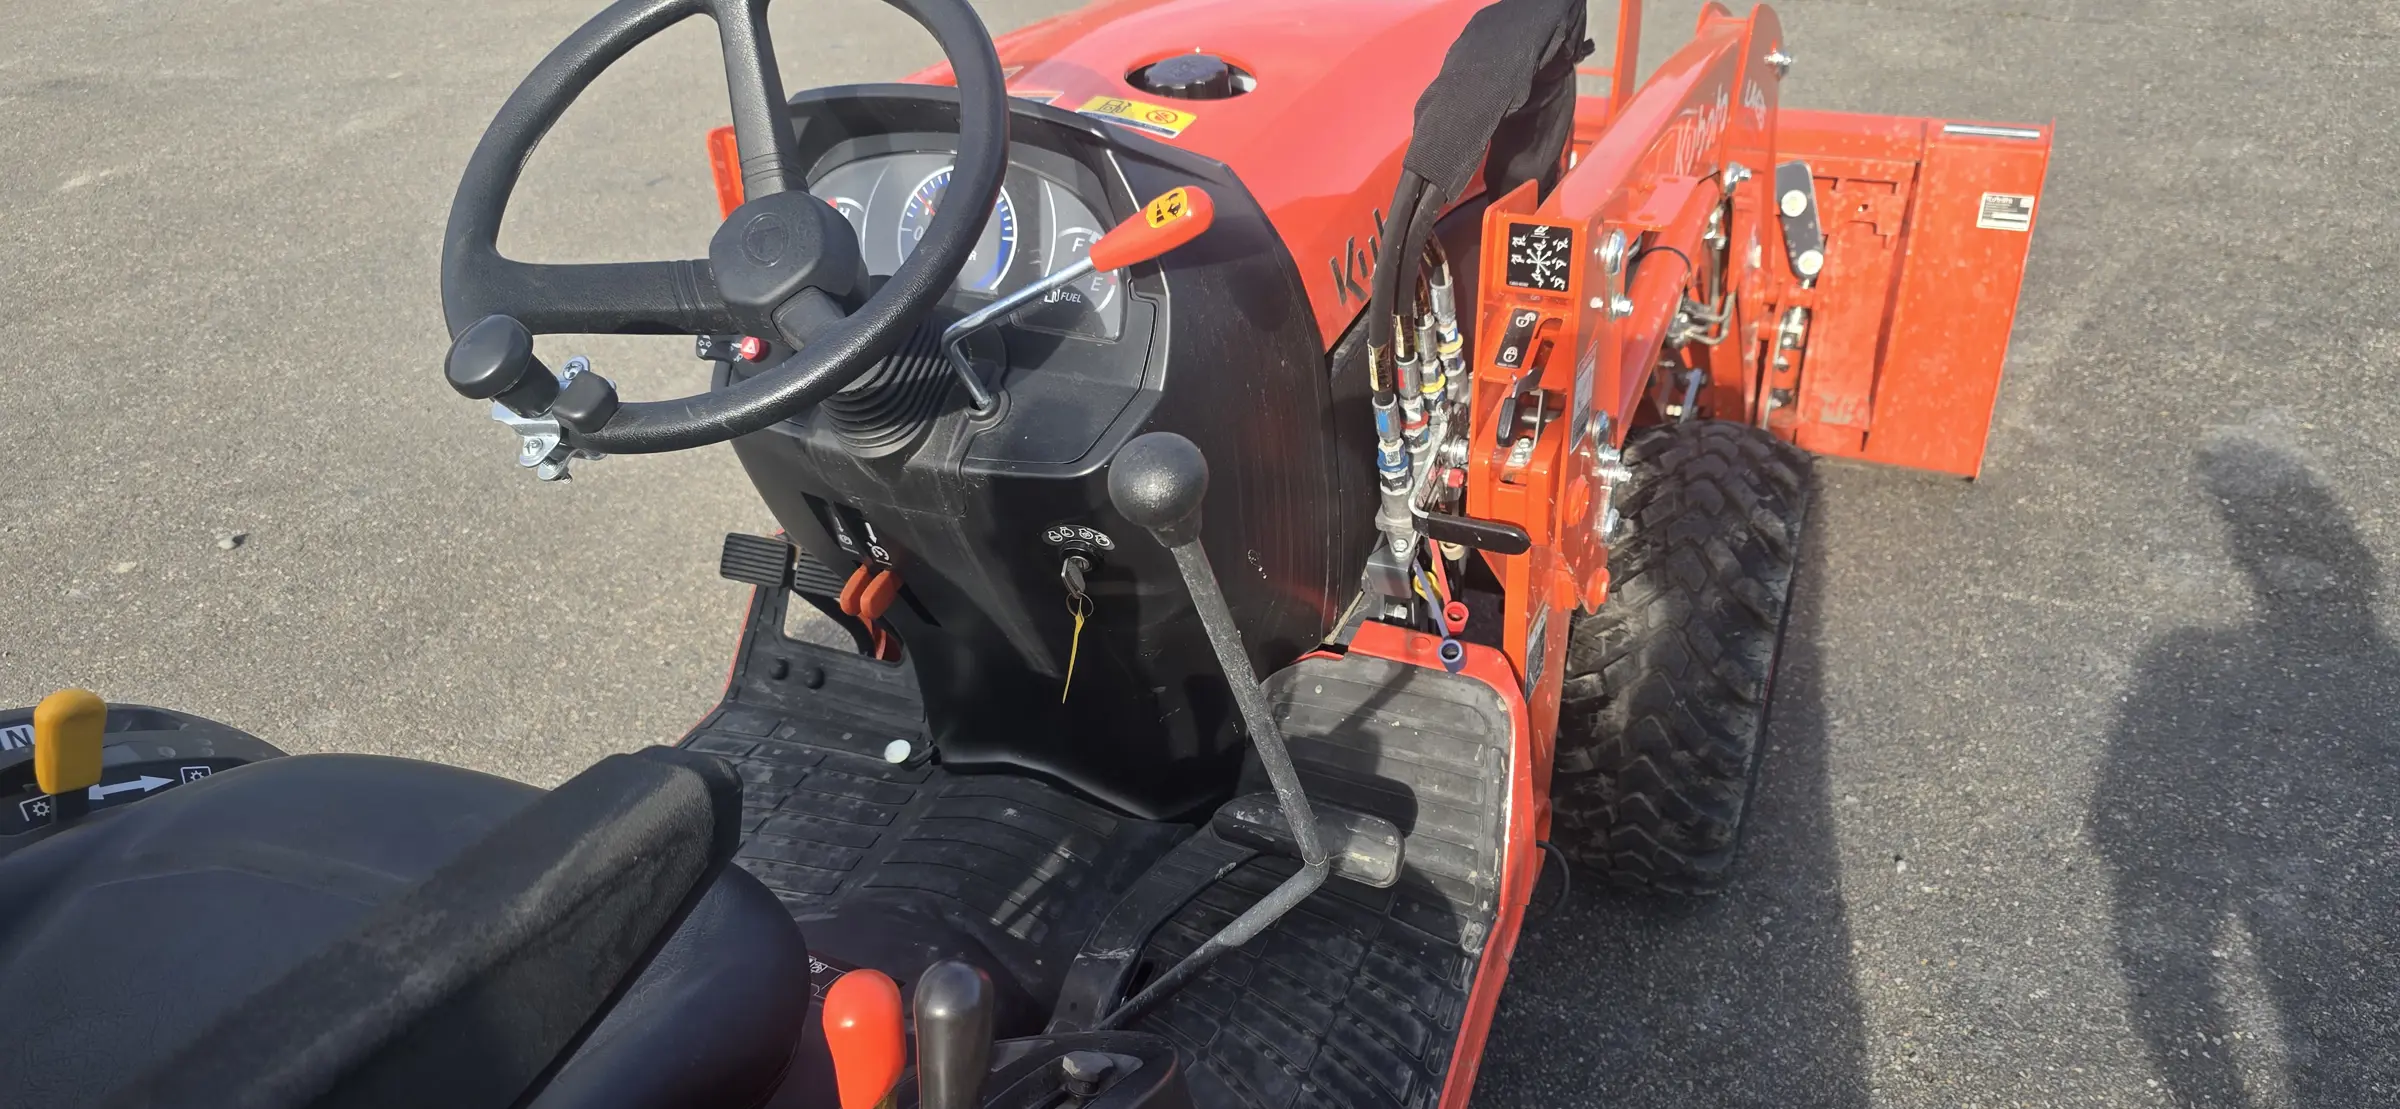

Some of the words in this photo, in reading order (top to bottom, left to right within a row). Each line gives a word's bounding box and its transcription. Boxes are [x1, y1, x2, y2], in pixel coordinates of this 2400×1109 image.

[1072, 237, 1086, 253] F
[1090, 276, 1104, 292] E
[1060, 291, 1082, 304] FUEL
[6, 727, 34, 750] N
